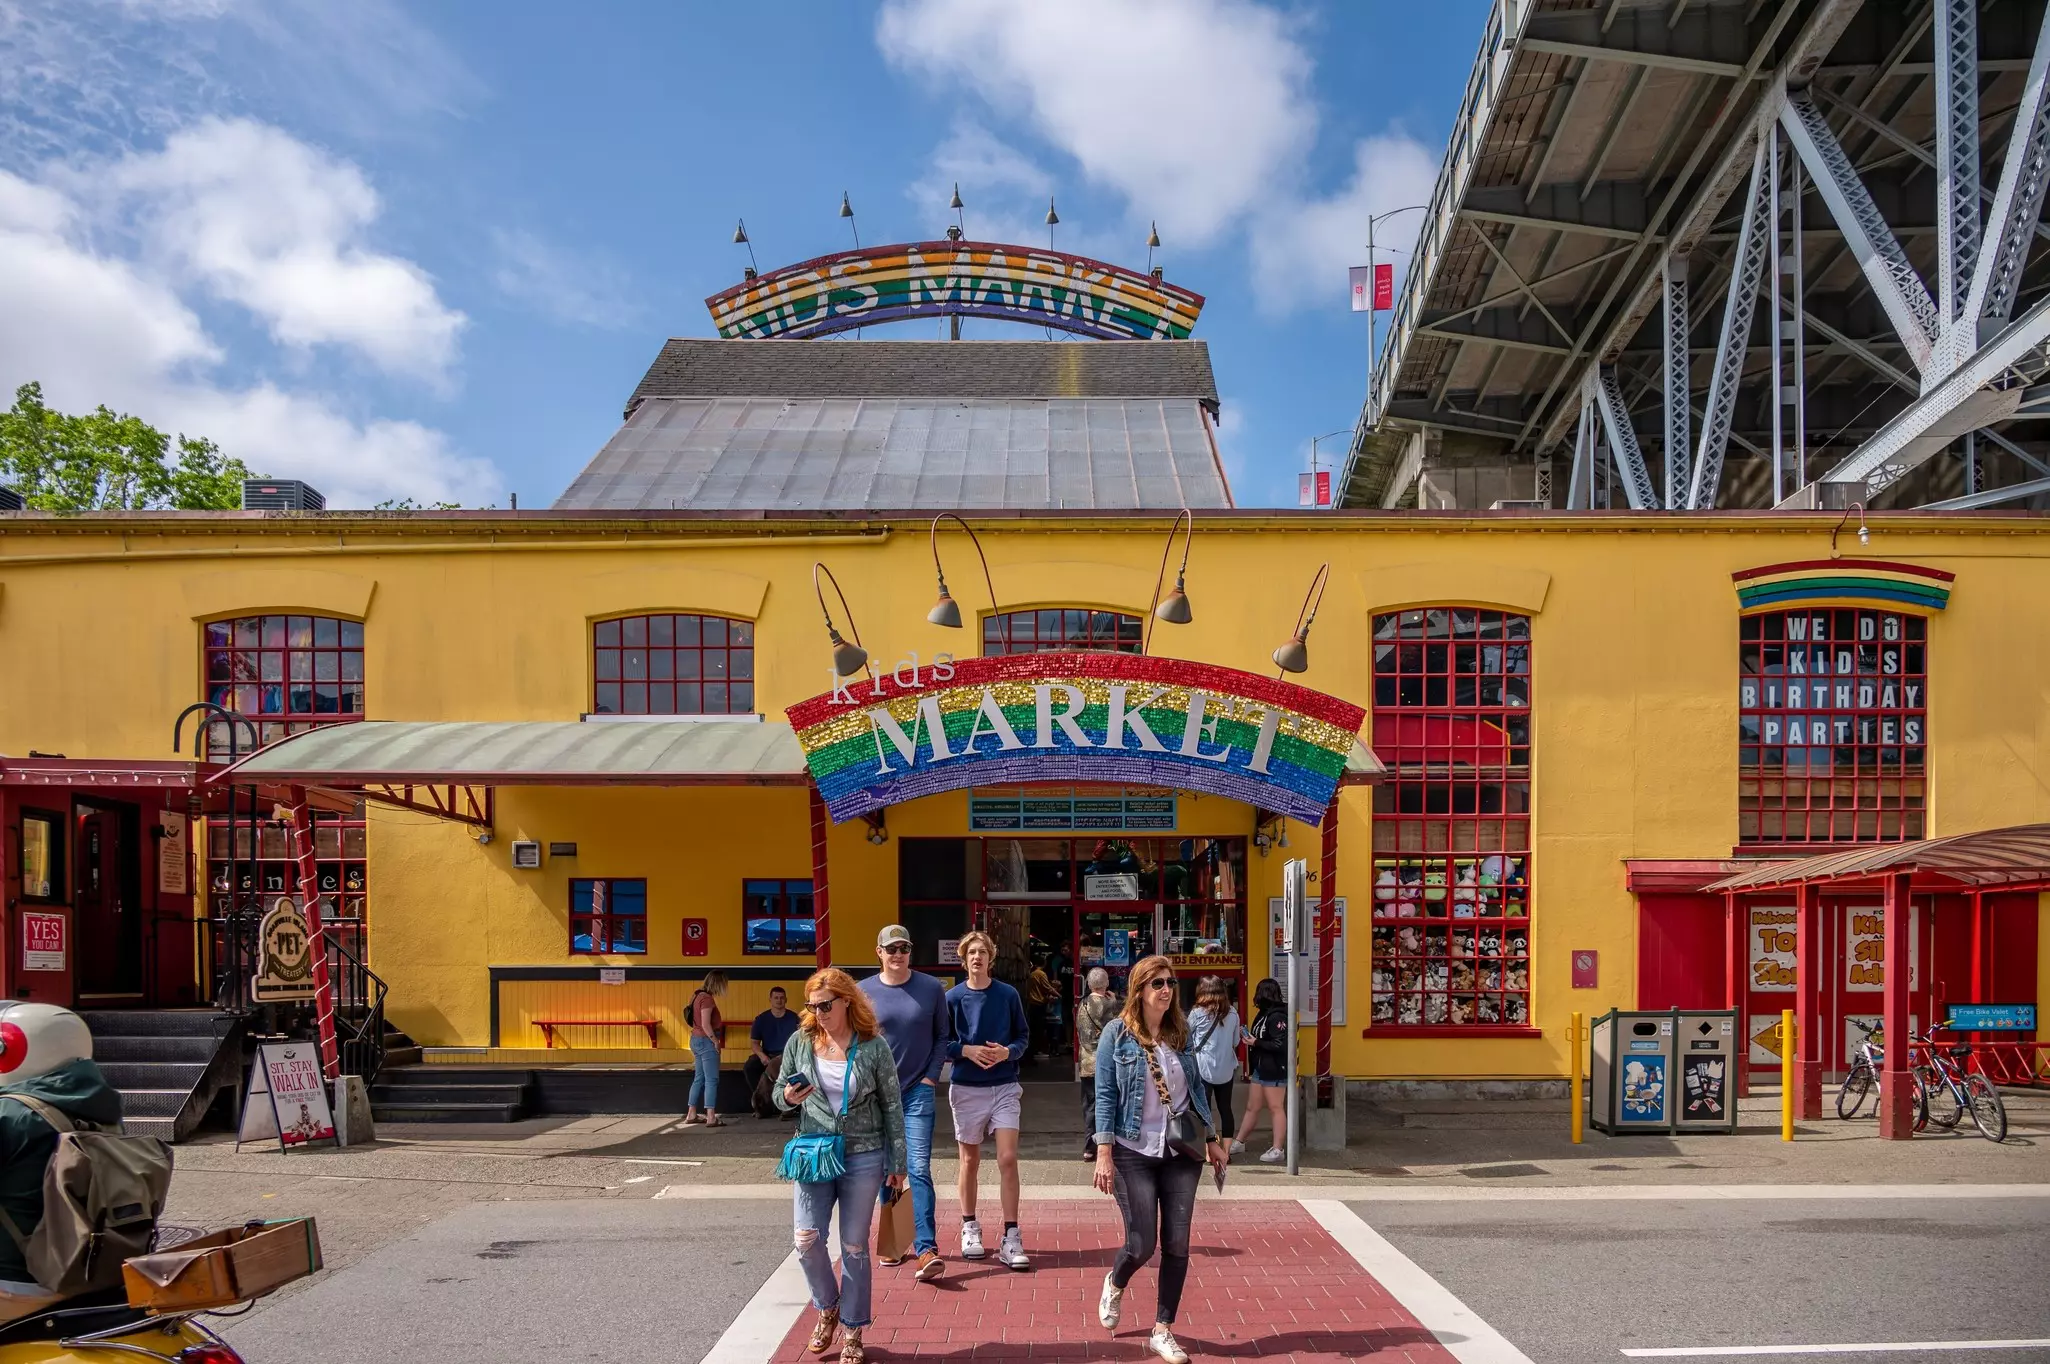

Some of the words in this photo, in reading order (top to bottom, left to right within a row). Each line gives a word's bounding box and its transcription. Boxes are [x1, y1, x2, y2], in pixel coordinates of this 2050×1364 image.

[716, 256, 879, 339] KIDS
[908, 246, 1195, 341] MARKET
[1787, 617, 1825, 640] WE
[1860, 617, 1898, 641] DO
[827, 651, 956, 706] kids
[1742, 685, 1919, 709] BIRTHDAY
[864, 684, 1300, 778] MARKET
[1765, 721, 1919, 745] PARTIES
[31, 920, 60, 940] YES
[32, 940, 44, 950] YOU
[277, 932, 301, 955] PET
[1758, 928, 1797, 958] To
[1854, 940, 1885, 962] Sil
[1189, 955, 1242, 965] ENTRANCE
[280, 966, 305, 978] TREATERY
[270, 1062, 288, 1074] SIT.
[273, 1073, 306, 1093] WALK
[306, 1072, 319, 1089] IN
